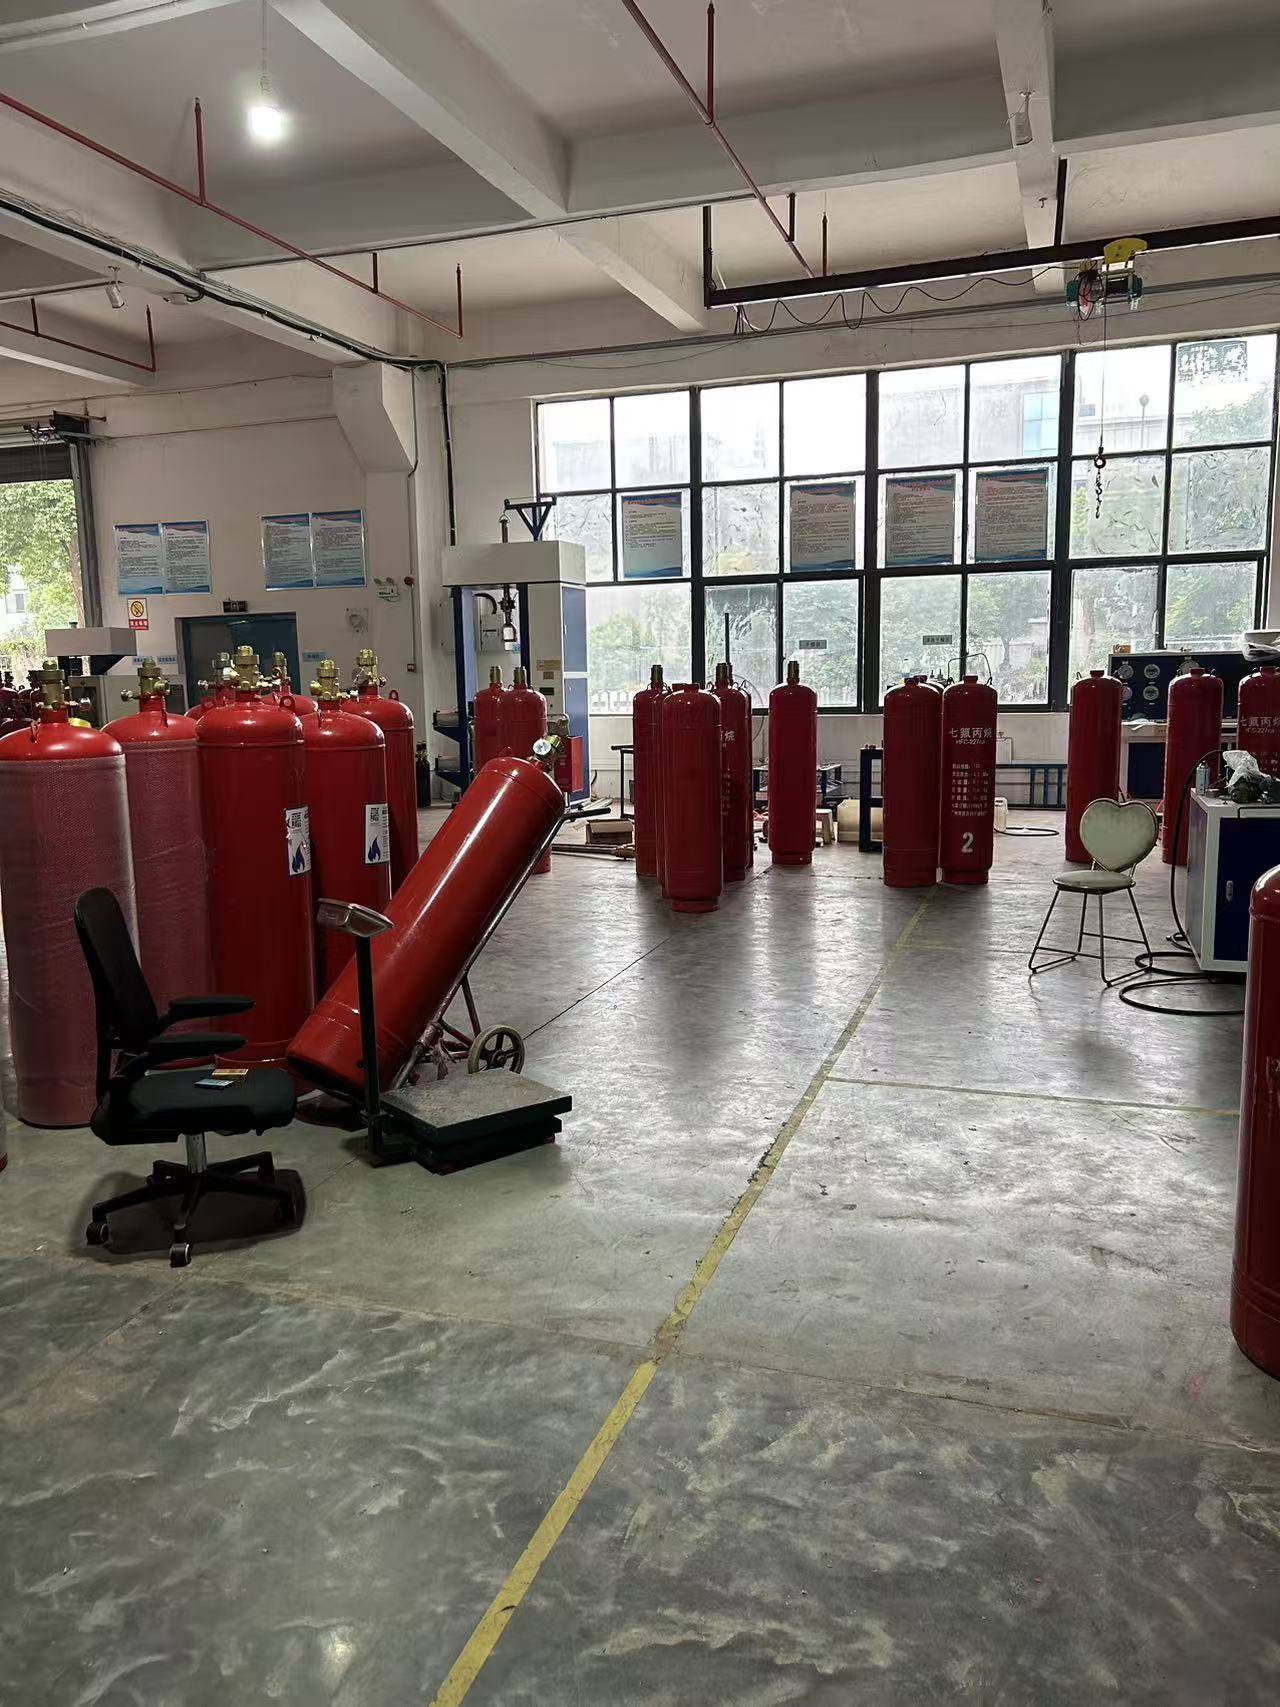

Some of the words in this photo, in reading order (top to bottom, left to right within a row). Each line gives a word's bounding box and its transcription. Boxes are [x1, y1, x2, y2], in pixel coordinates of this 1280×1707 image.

[948, 727, 992, 739] 七氟丙烷
[961, 831, 974, 853] 2
